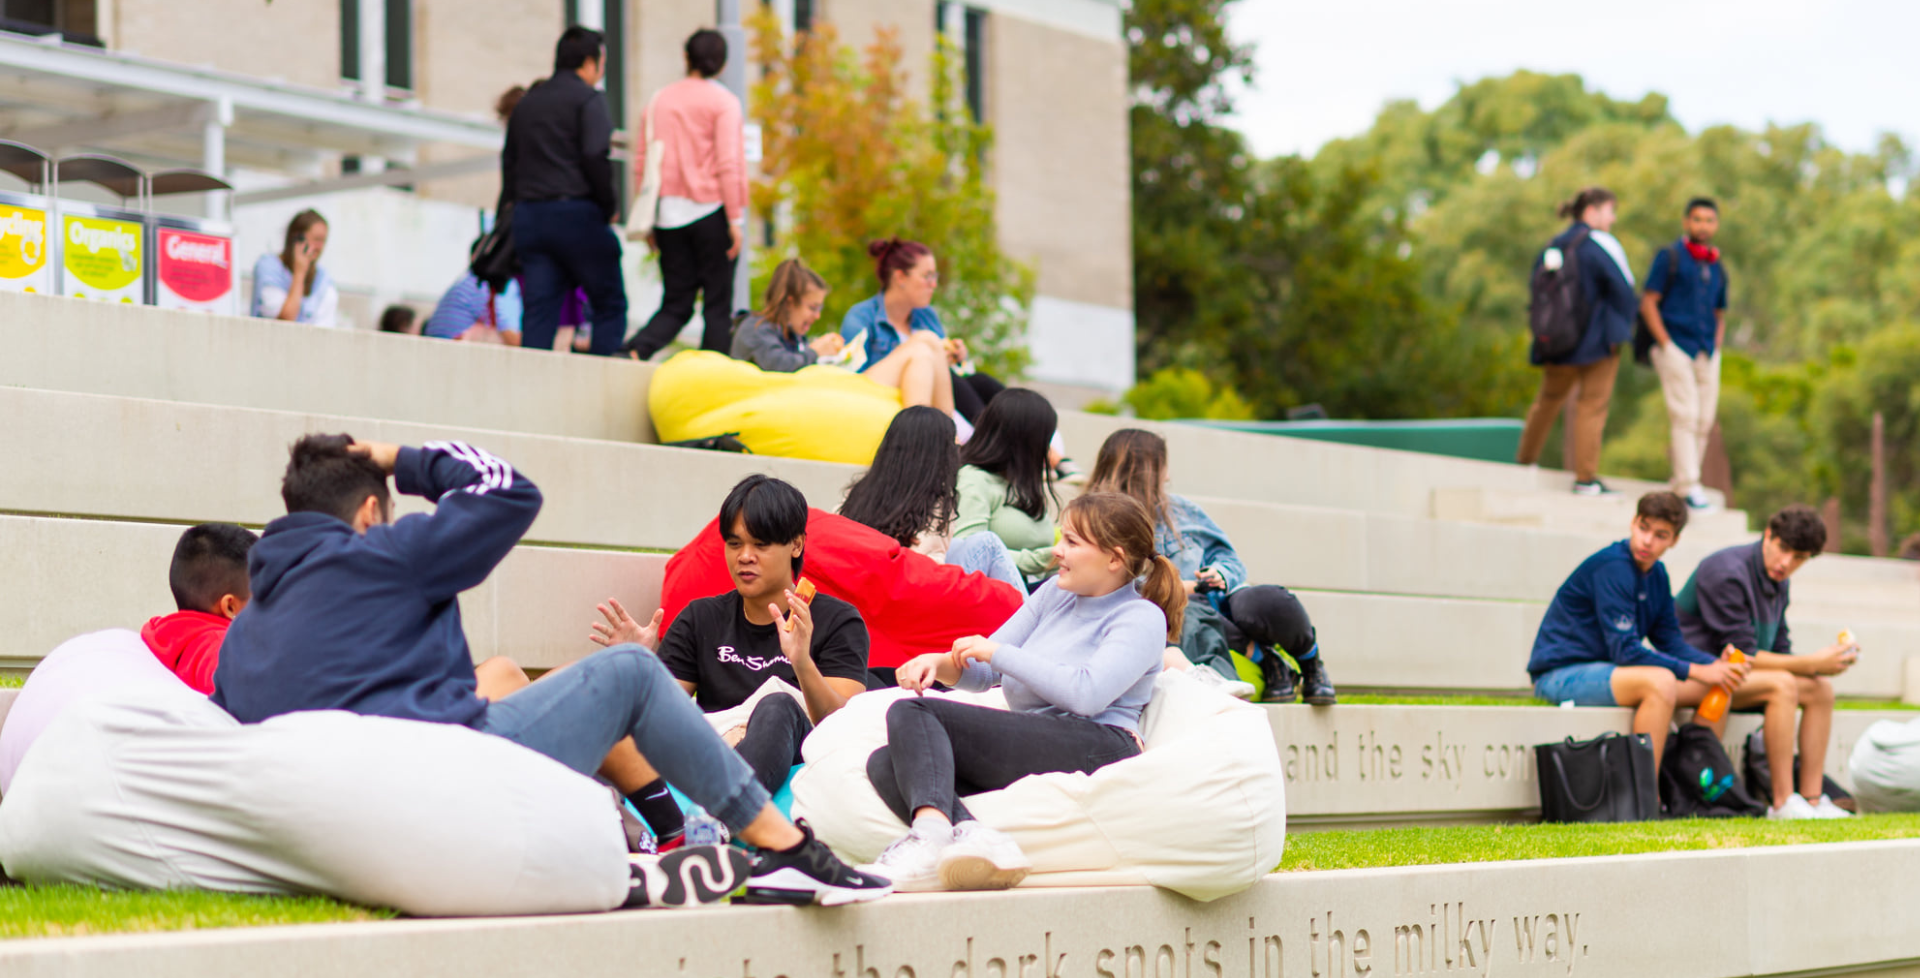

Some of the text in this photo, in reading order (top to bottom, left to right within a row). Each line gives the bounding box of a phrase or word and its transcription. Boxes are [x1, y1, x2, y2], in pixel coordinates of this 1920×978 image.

[69, 221, 136, 254] Organics
[166, 235, 226, 264] General
[717, 646, 745, 665] Ben
[1286, 731, 1338, 781] and
[1358, 731, 1403, 781] the
[1422, 731, 1466, 791] sky
[1249, 916, 1285, 978] in
[1309, 910, 1373, 978] the
[1395, 901, 1496, 978] milky
[1513, 912, 1589, 977] way.
